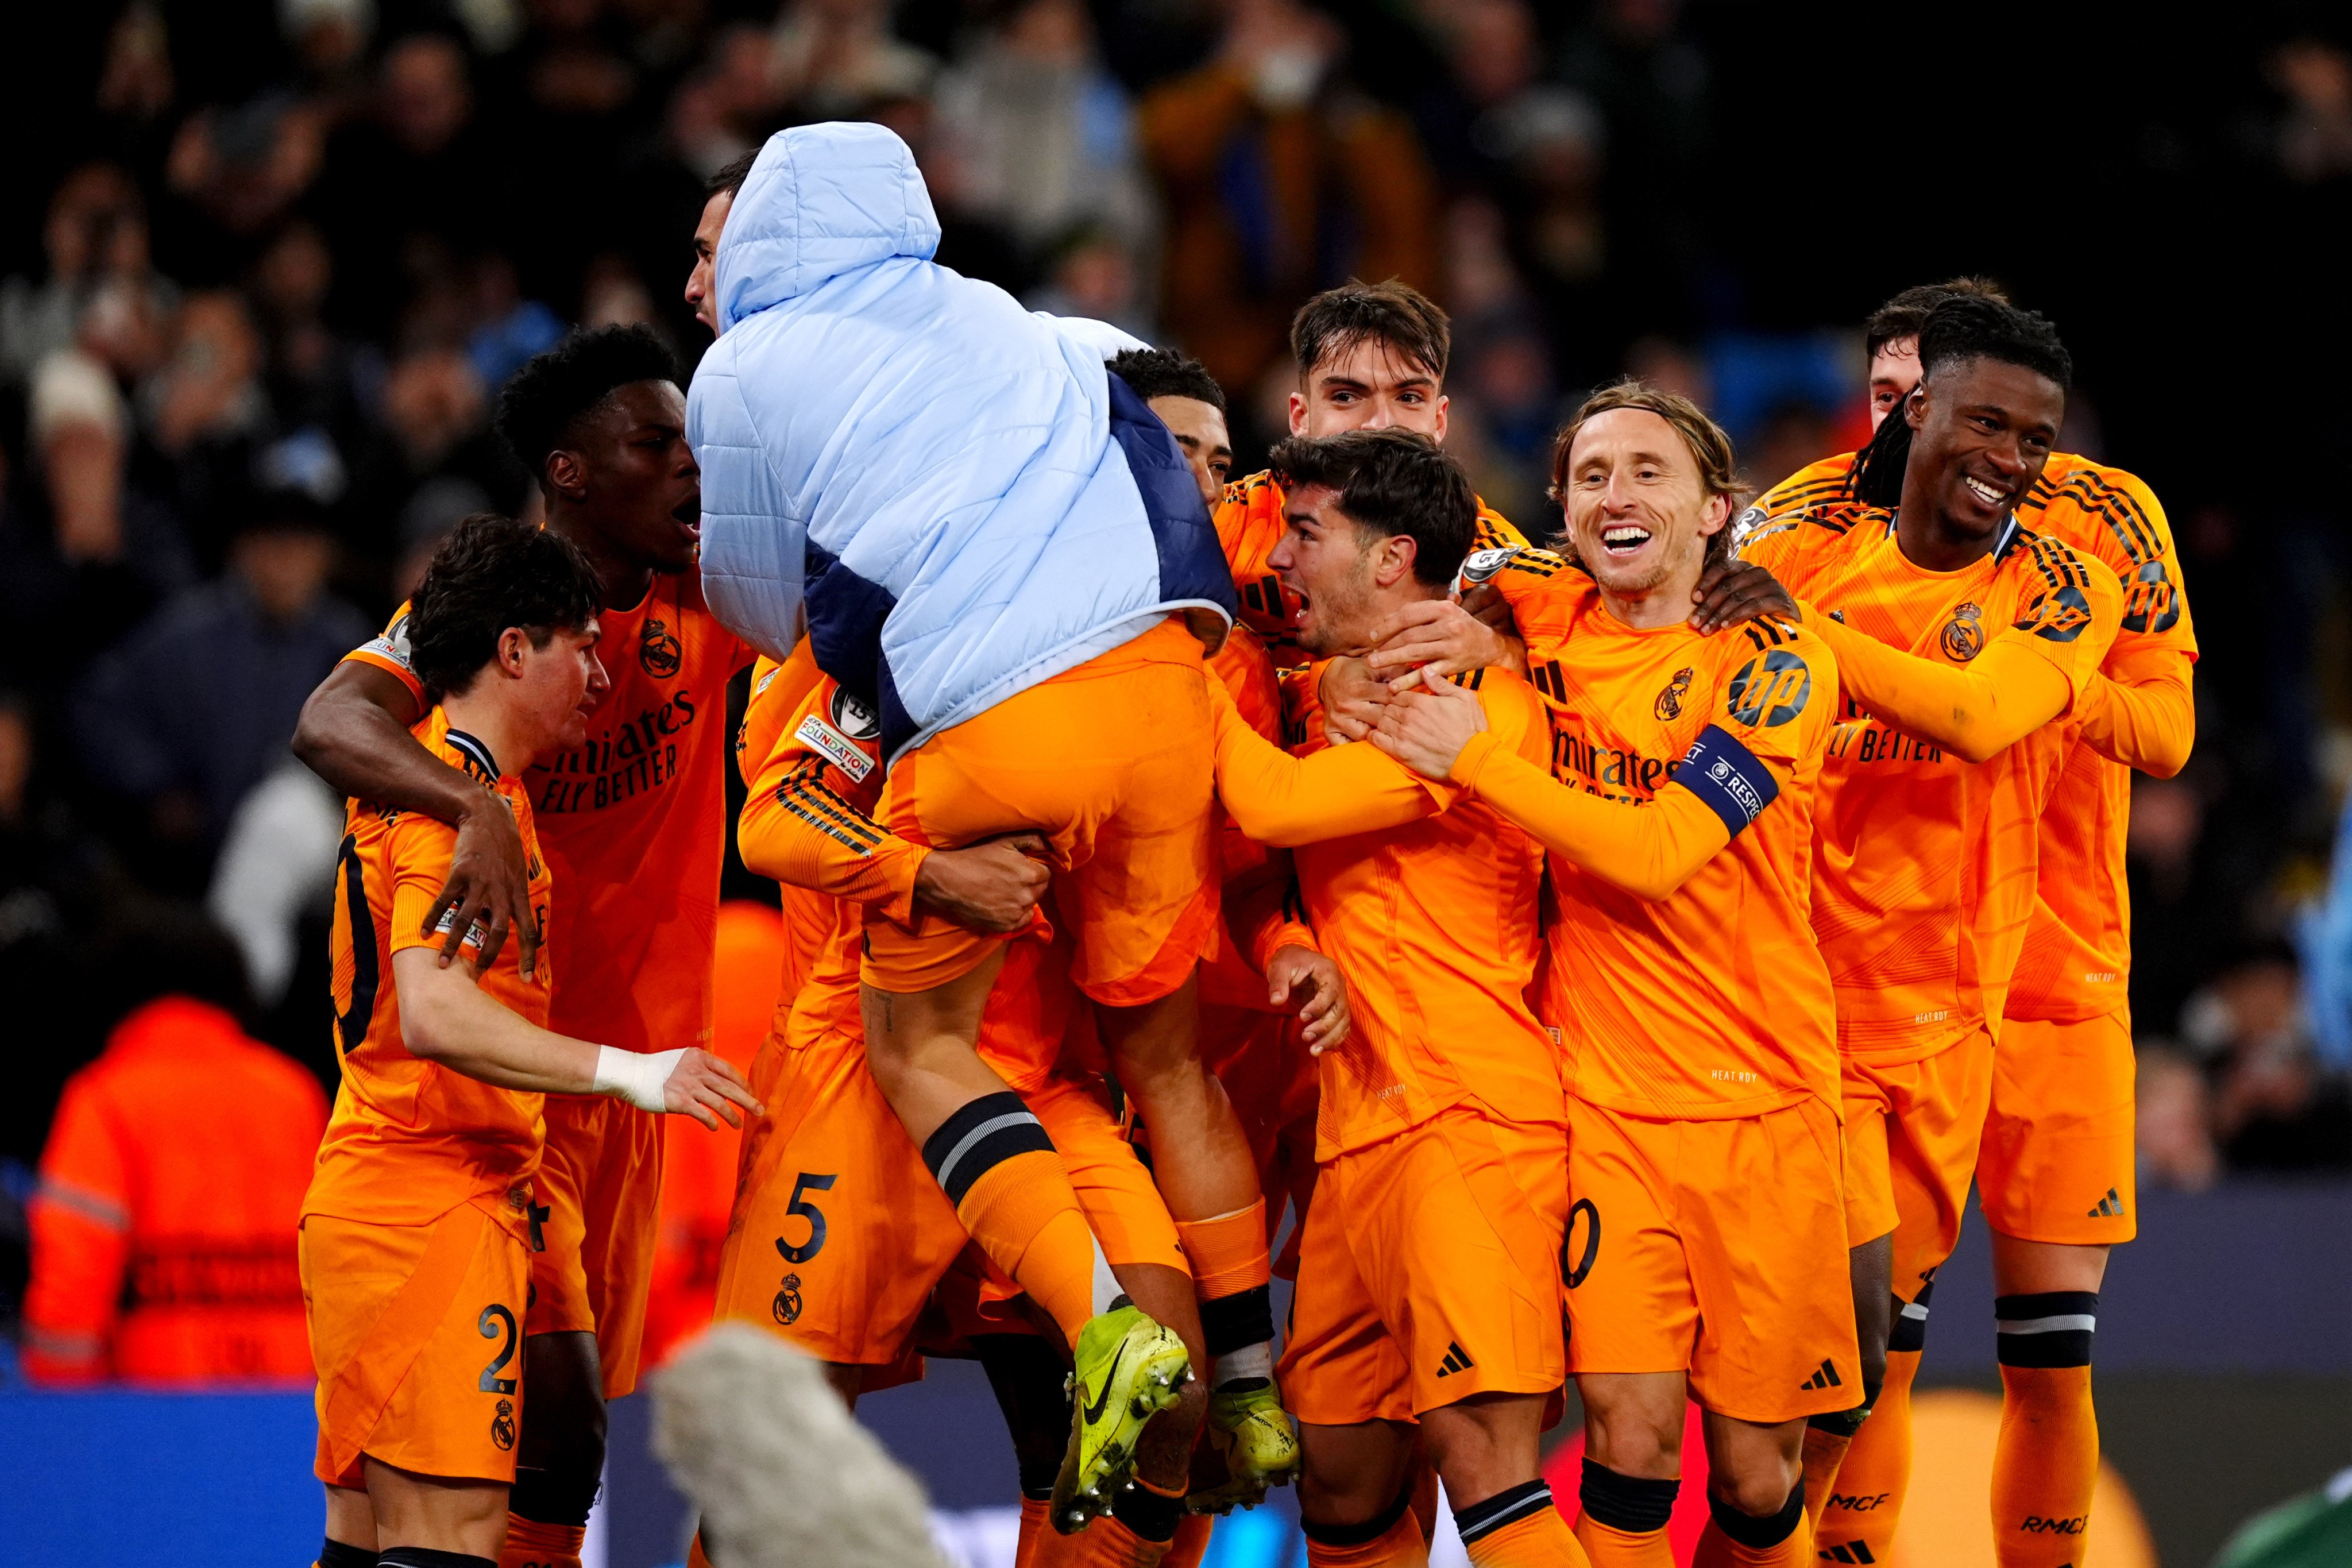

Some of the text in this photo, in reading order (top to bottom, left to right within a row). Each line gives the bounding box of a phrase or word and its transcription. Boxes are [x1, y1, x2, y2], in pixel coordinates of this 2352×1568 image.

[848, 701, 869, 720] 15
[1731, 649, 1809, 728] hp
[801, 721, 869, 776] FOUNDATION
[540, 744, 677, 814] FLY BETTER
[1727, 776, 1761, 821] RESPEC
[1712, 1069, 1758, 1083] HEAT.RDY
[775, 1172, 838, 1264] 5
[478, 1303, 517, 1396] 2
[1826, 1493, 1890, 1511] MCF
